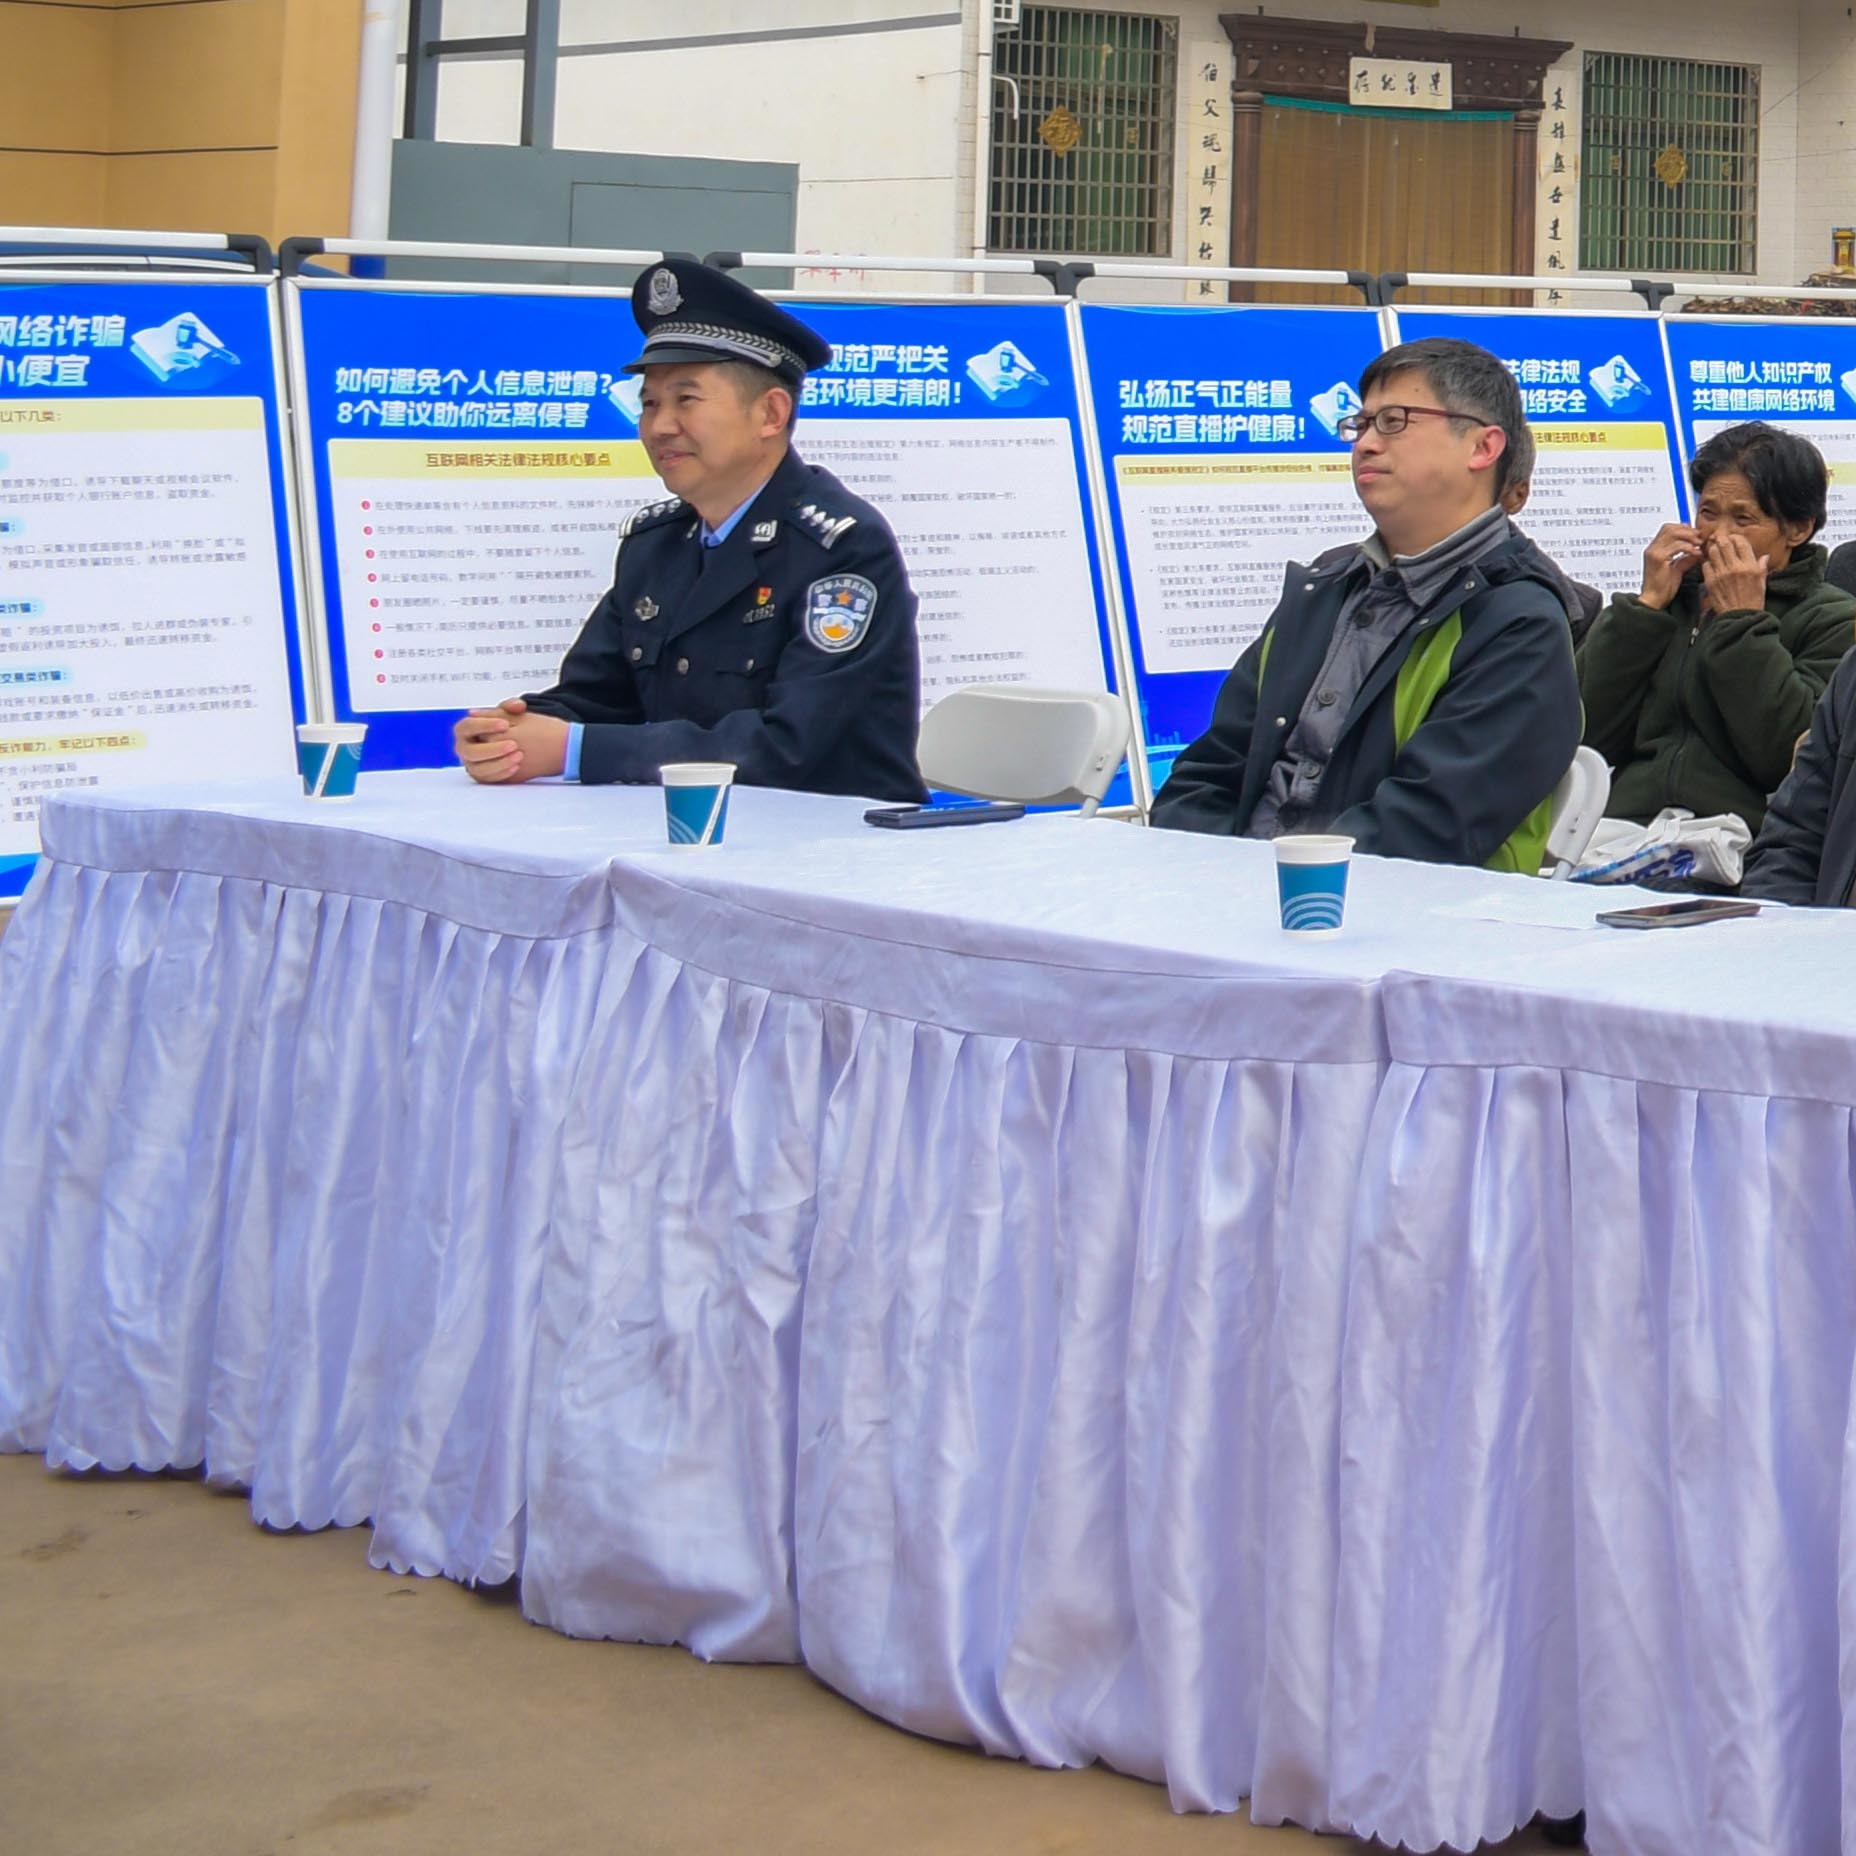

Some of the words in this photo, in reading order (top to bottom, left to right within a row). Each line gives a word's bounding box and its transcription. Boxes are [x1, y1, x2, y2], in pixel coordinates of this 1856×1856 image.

[336, 367, 612, 396] 如何避免个人信息泄露？
[1690, 360, 1833, 384] 尊重他人知识产权
[1119, 380, 1292, 408] 弘扬正气正能量
[1692, 389, 1836, 412] 共建健康网络环境
[337, 400, 589, 428] 8个建议助你远离侵害
[1122, 414, 1305, 443] 规范直播护健康！
[426, 453, 611, 468] 互联网相关法律法规核心要点
